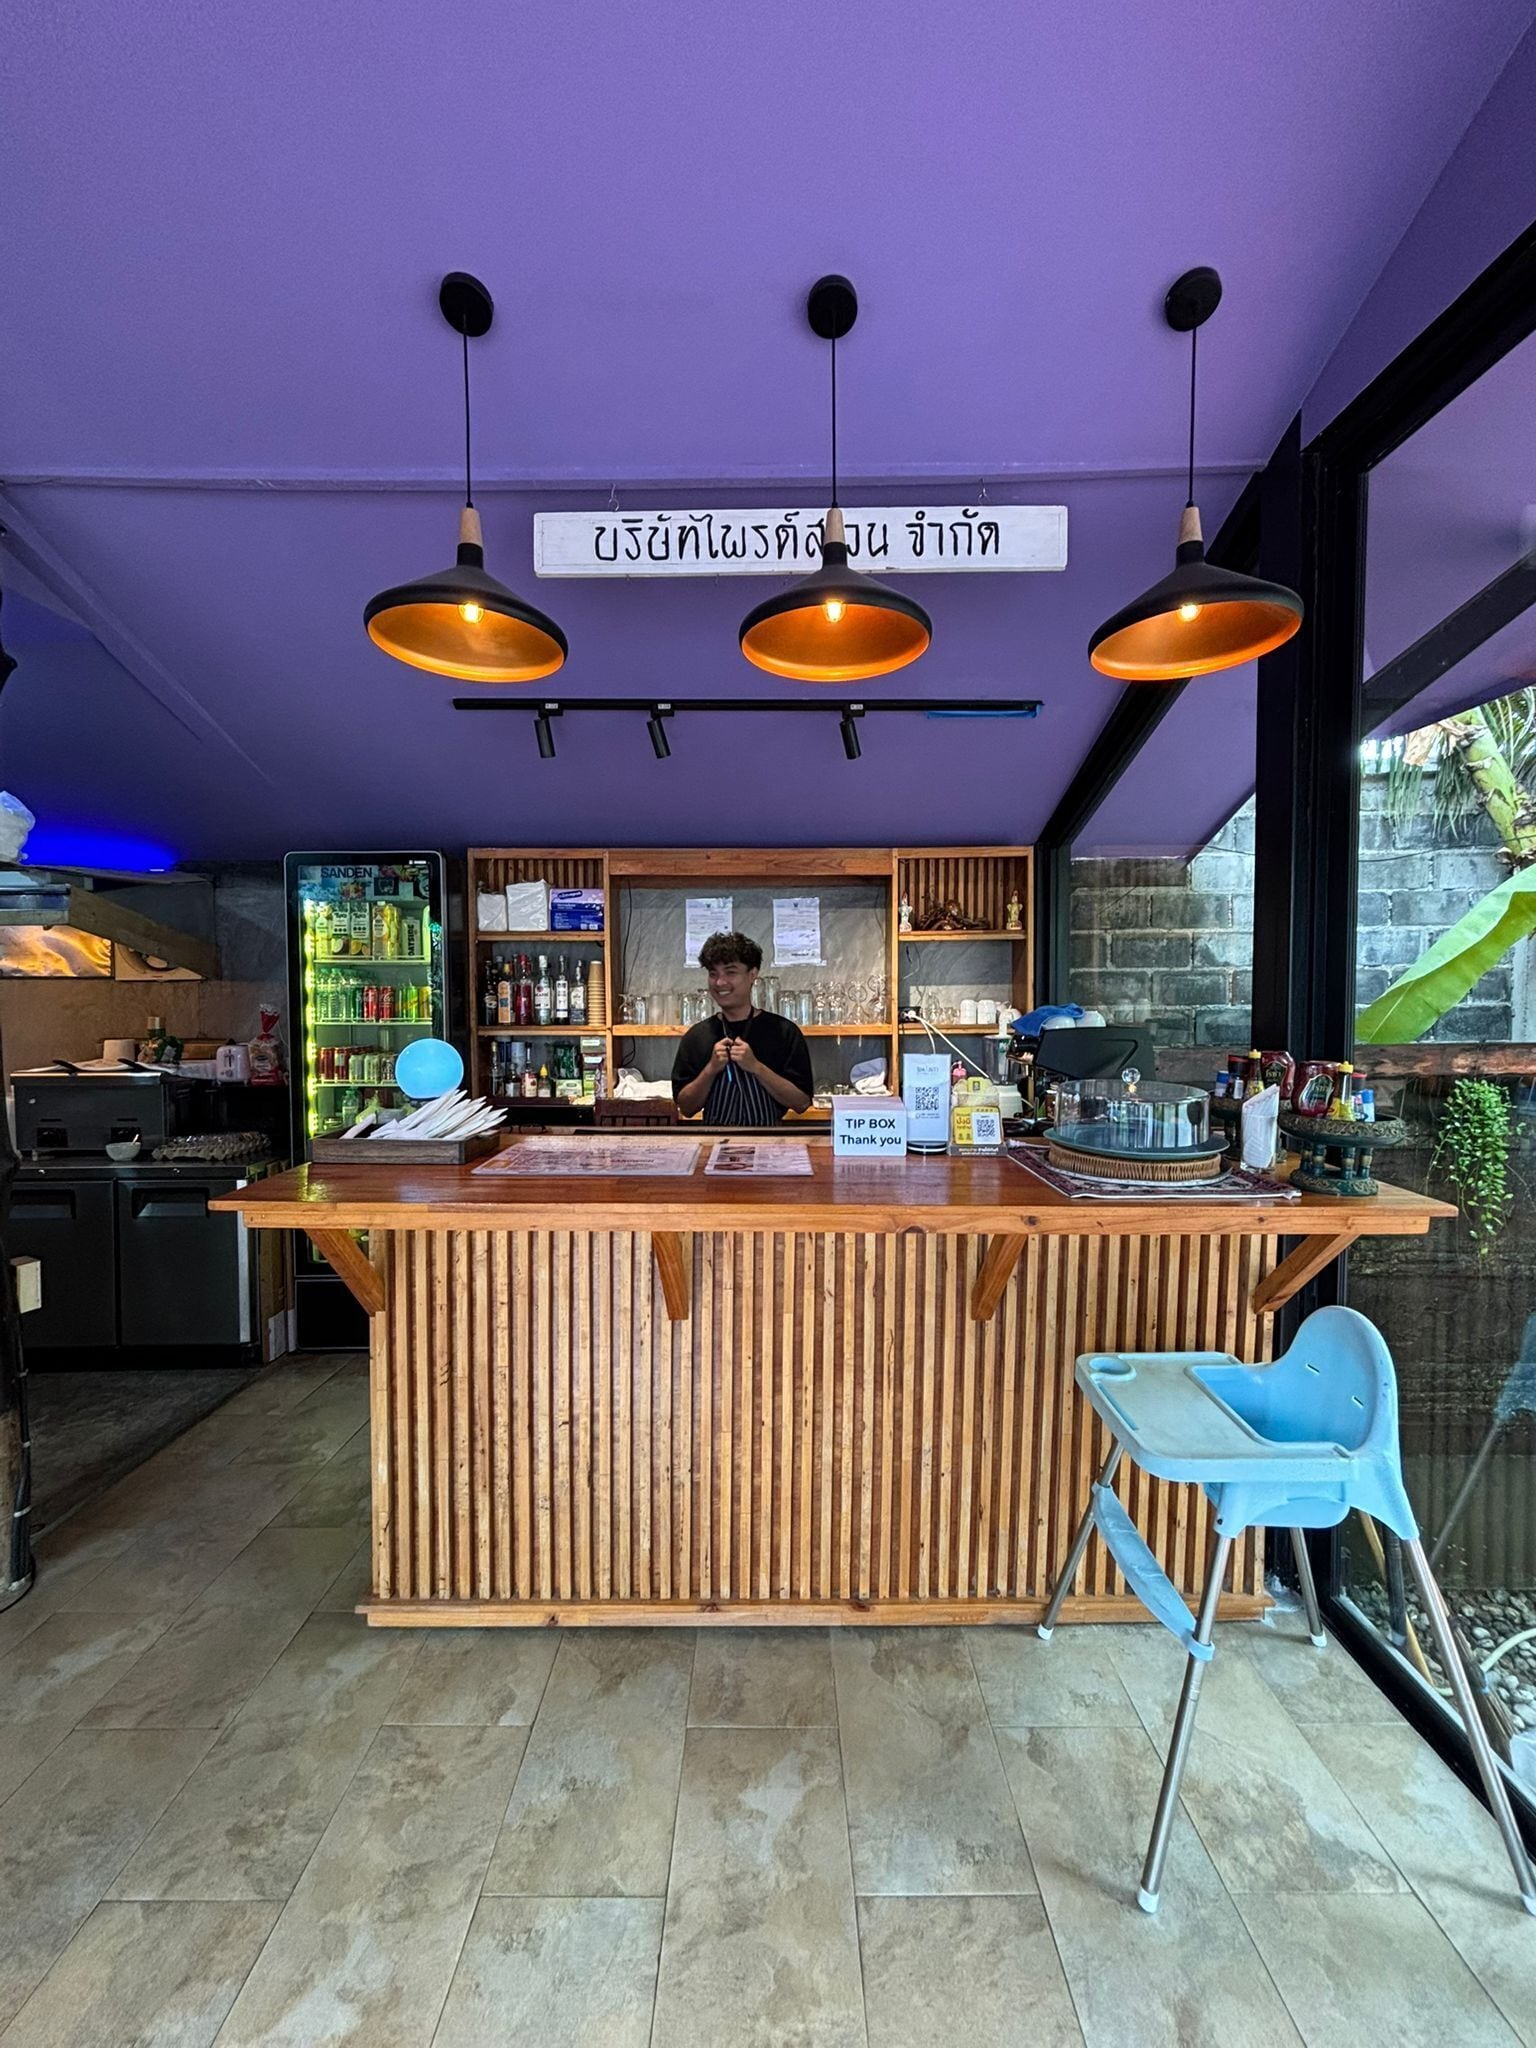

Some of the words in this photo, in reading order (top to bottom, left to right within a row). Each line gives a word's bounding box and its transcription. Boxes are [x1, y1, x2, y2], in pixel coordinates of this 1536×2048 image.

[905, 508, 999, 556] จำกัด
[321, 867, 373, 878] SANDEN
[845, 1118, 866, 1129] TIP
[869, 1118, 896, 1129] BOX
[839, 1134, 877, 1145] Thank
[880, 1136, 902, 1147] you
